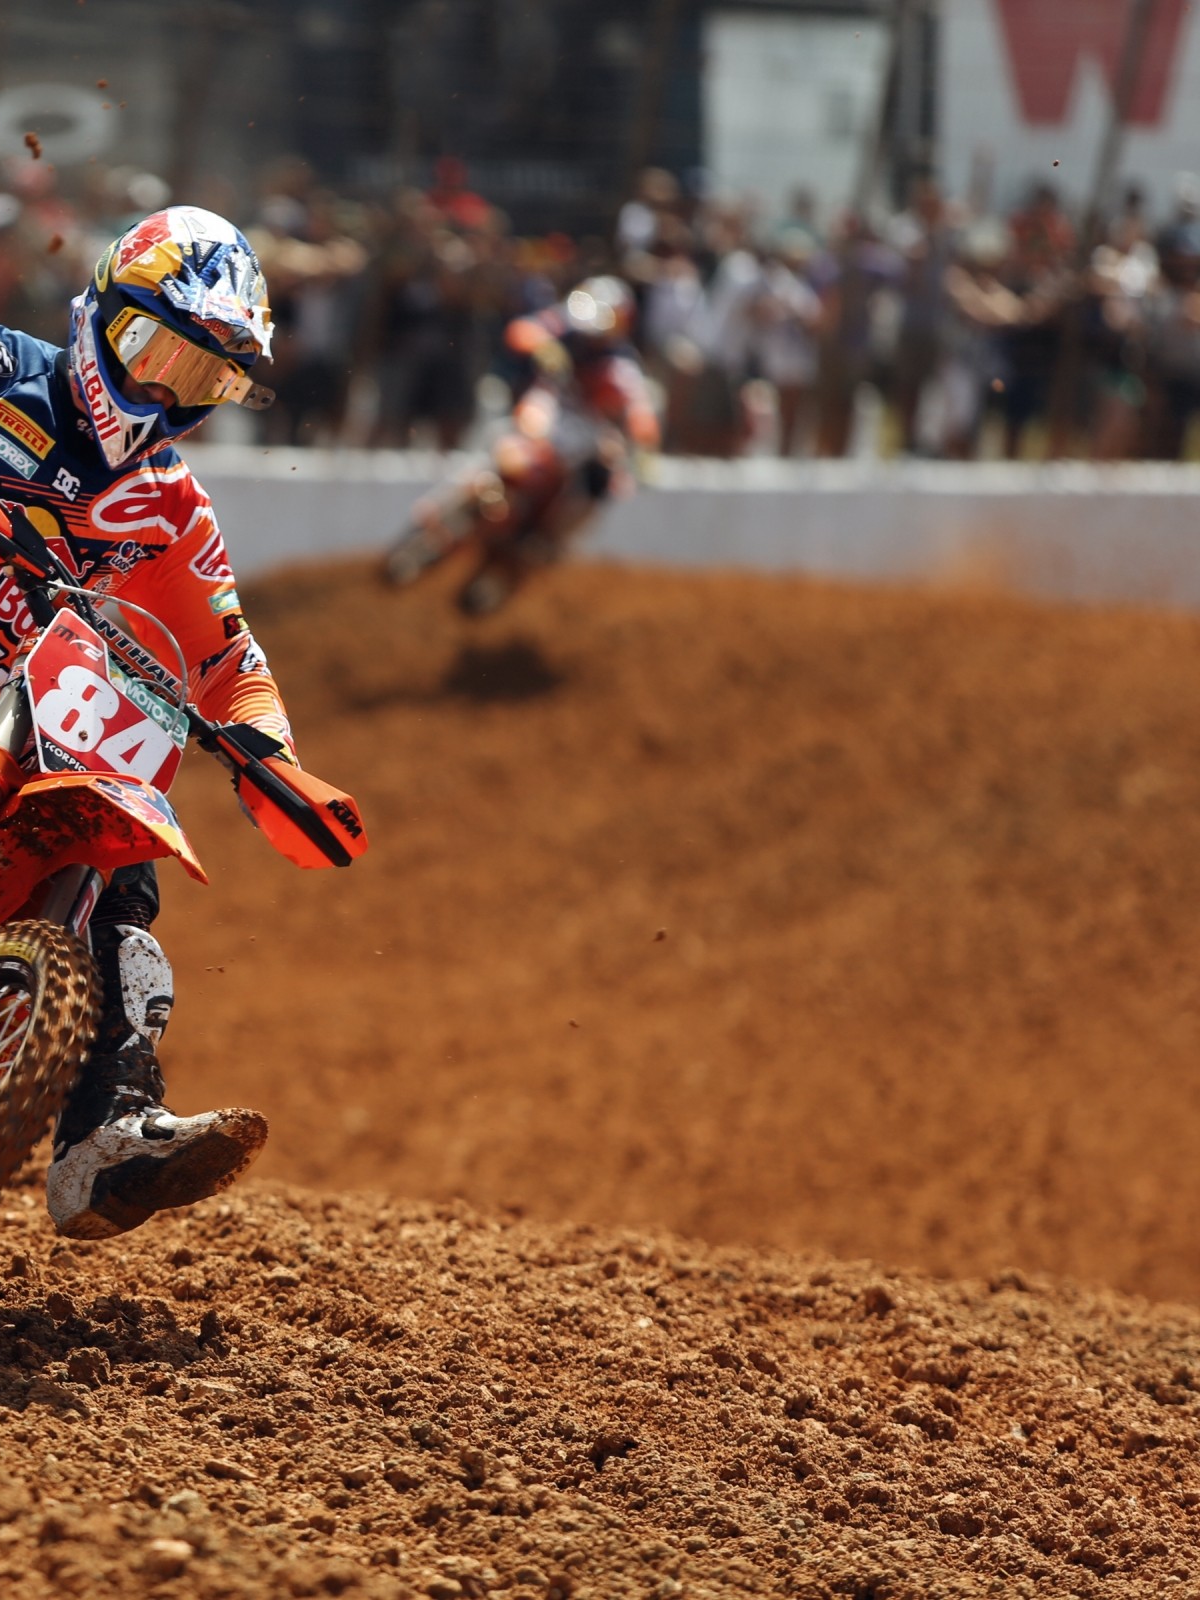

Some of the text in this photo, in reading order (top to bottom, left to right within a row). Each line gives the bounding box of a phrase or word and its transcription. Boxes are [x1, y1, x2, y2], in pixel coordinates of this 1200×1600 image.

[84, 376, 122, 441] Bull
[52, 467, 81, 502] DC
[35, 664, 175, 785] 84
[123, 680, 189, 744] MOTOREX
[44, 740, 88, 772] SCORPIO
[326, 799, 363, 840] KTM
